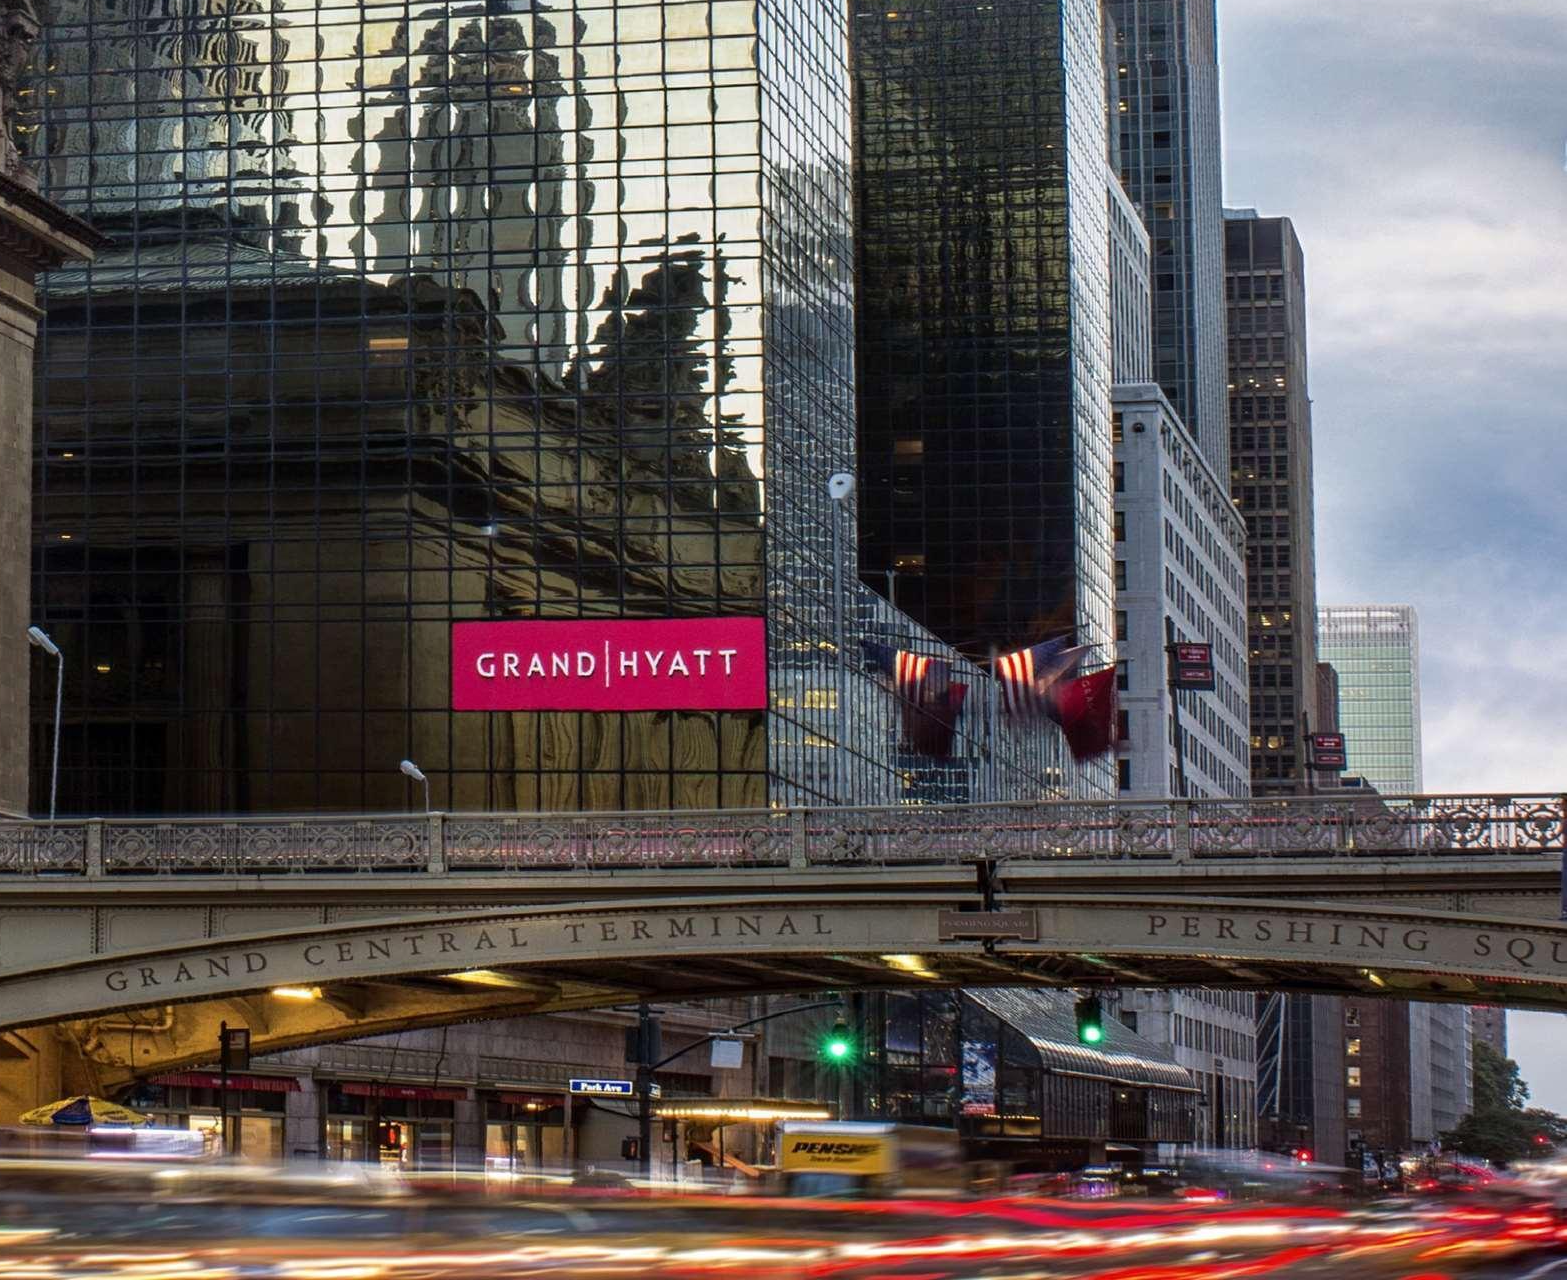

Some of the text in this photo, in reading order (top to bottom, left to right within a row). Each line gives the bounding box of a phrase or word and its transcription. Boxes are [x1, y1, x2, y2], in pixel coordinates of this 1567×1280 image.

[476, 649, 738, 678] GRAND HYATT
[1147, 914, 1431, 952] PERSHING
[105, 913, 833, 992] GRAND CENTRAL TERMINAL
[580, 1082, 623, 1092] Park Ave
